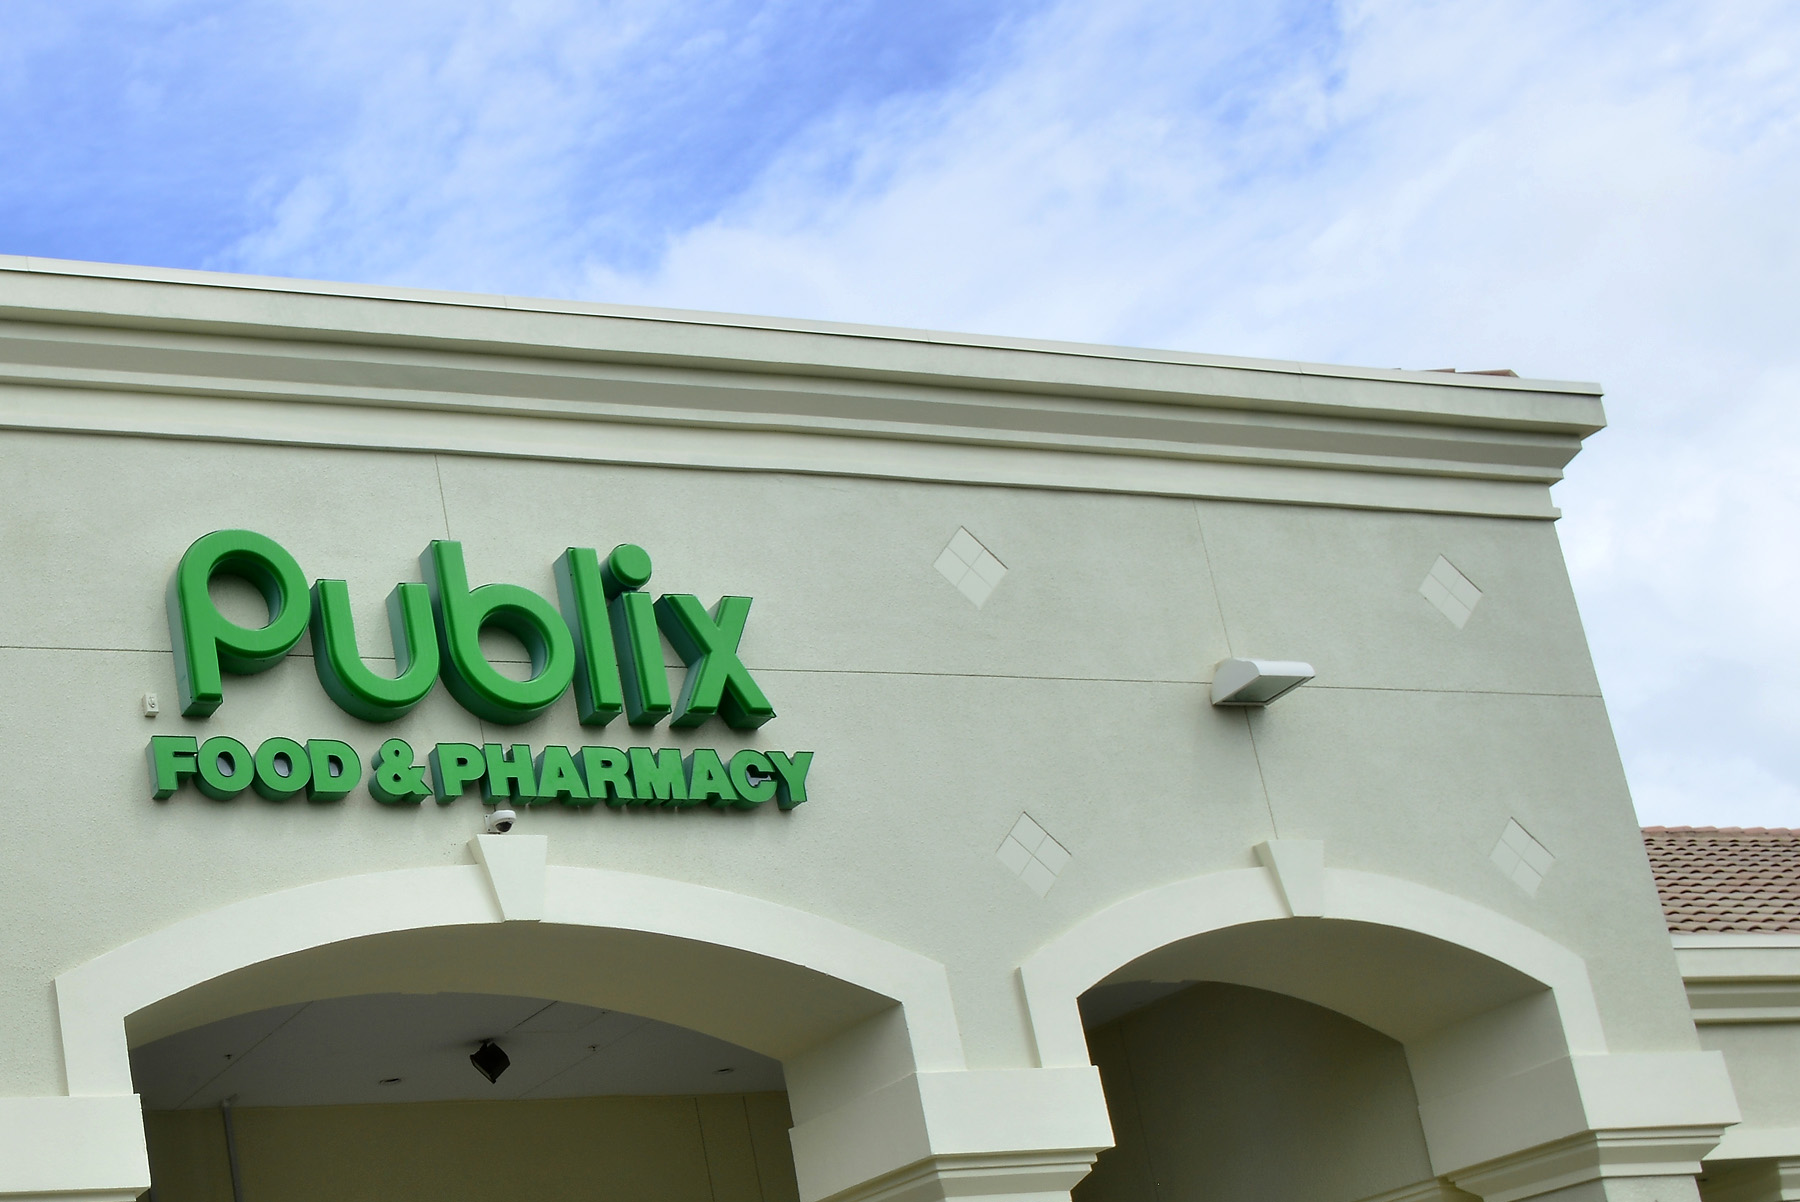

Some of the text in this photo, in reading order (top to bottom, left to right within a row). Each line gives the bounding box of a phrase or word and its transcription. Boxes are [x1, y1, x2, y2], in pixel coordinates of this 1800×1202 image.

[166, 529, 777, 729] Publix
[146, 735, 814, 811] FOOD & PHARMACY
